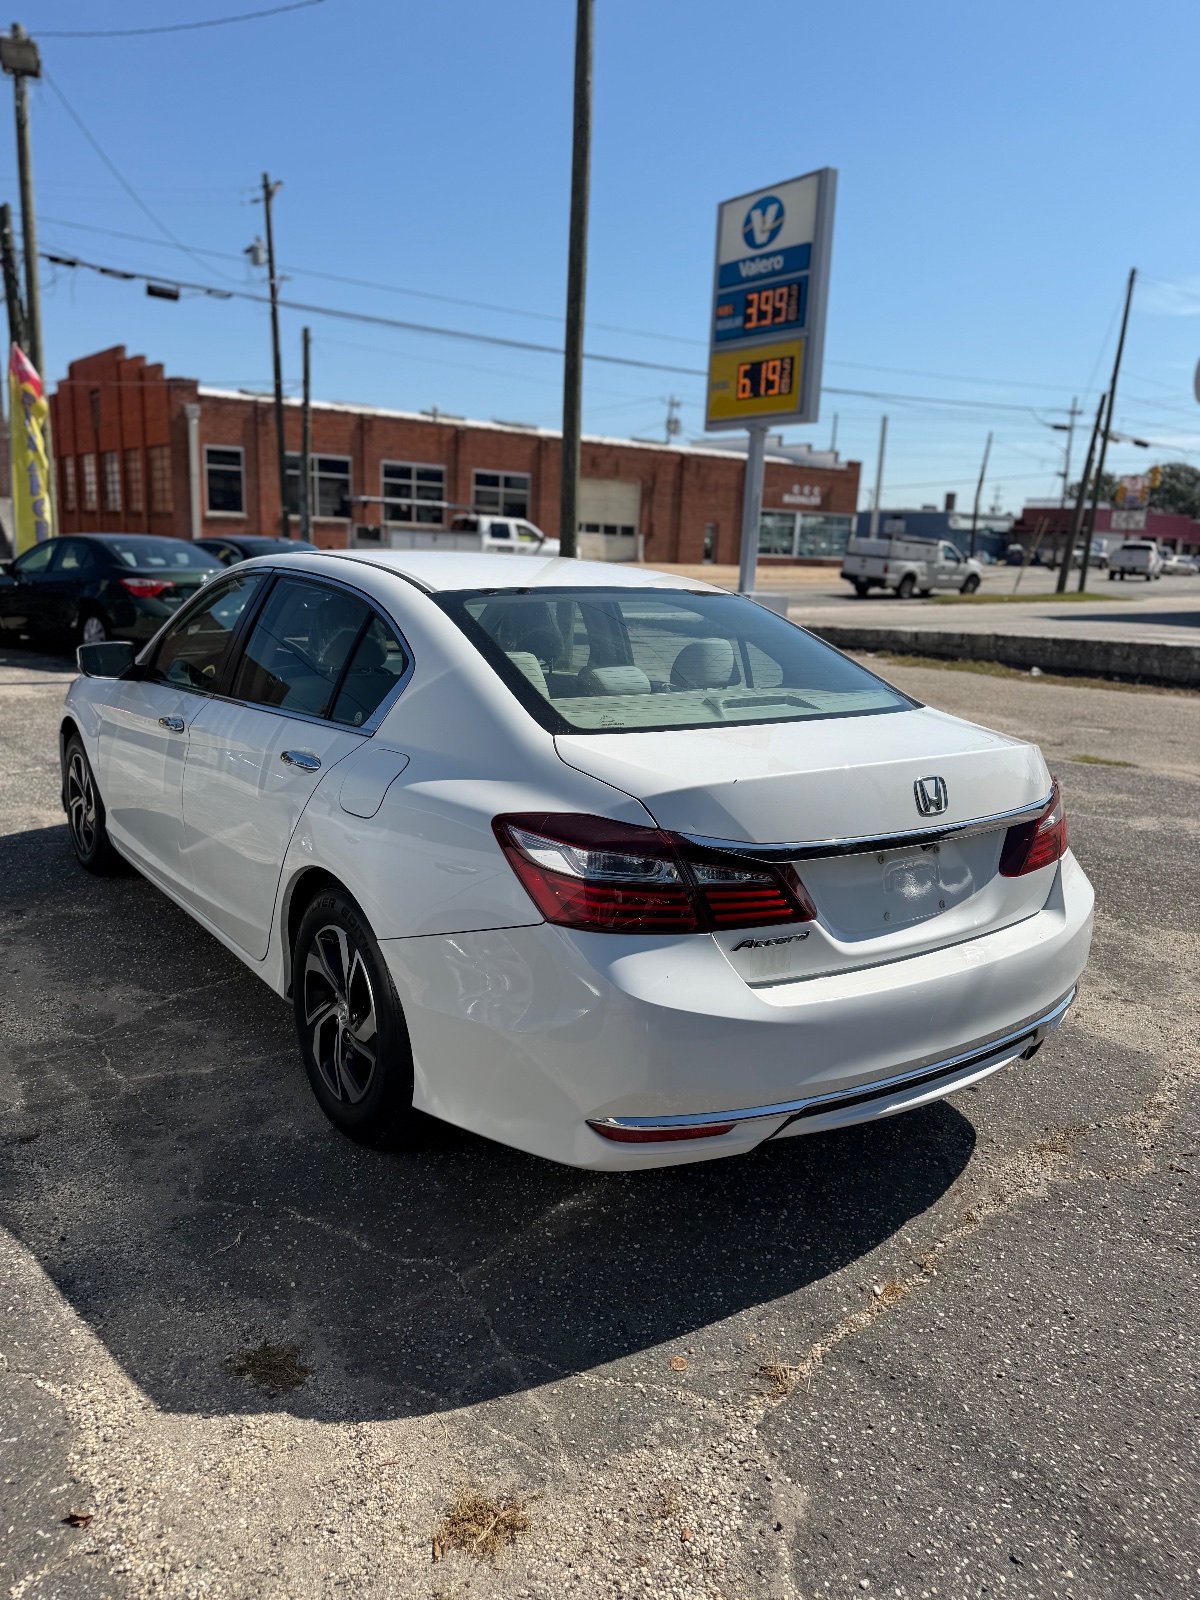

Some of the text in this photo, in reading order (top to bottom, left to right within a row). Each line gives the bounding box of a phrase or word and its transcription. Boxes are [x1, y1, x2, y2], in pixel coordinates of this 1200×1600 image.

[738, 255, 784, 278] Valero
[744, 286, 789, 329] 3.99
[736, 359, 781, 399] 6.19
[730, 930, 810, 952] Accord
